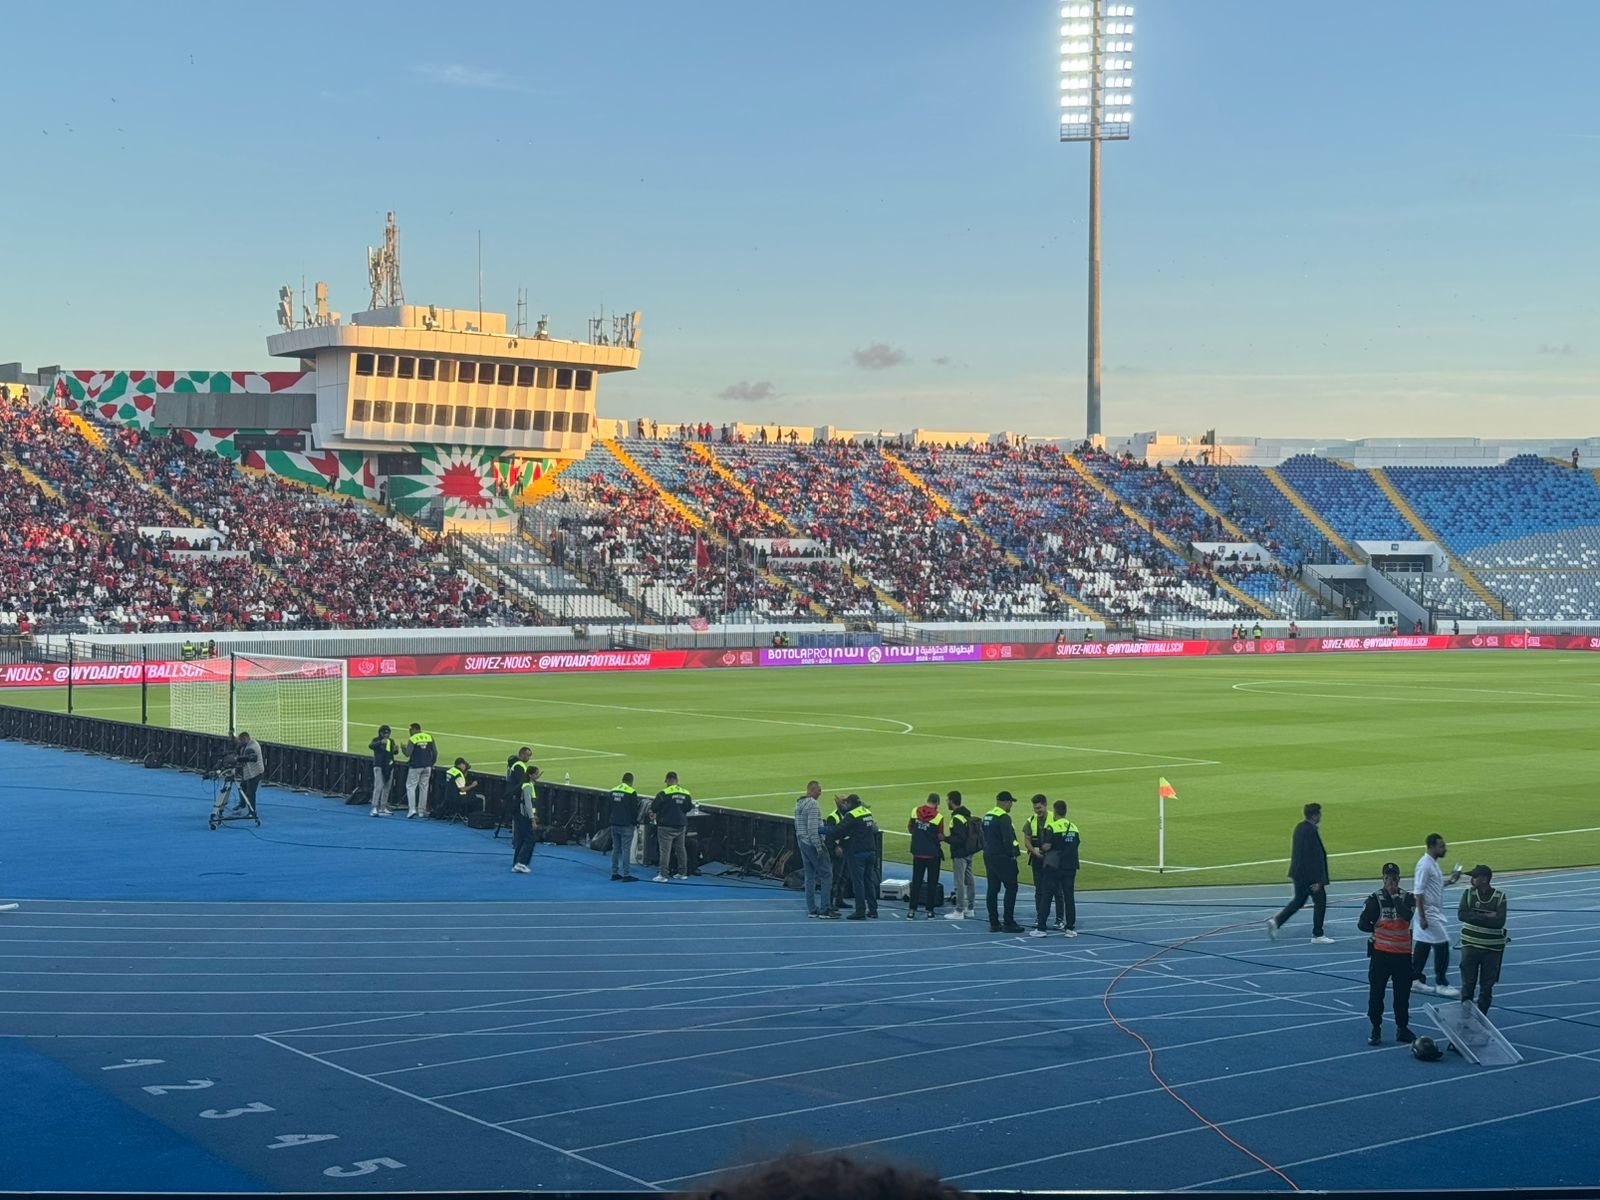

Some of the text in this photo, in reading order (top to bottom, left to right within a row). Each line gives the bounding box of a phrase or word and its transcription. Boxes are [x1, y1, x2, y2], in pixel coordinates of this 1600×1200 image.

[1056, 643, 1102, 656] SUIVEZ-NOUS
[465, 656, 532, 670] SUIVEZ-NOUS
[539, 653, 651, 669] @WYDADFOOTBALLSCH
[0, 667, 44, 682] -NOUS
[101, 1058, 166, 1071] 1
[141, 1079, 216, 1096] 2
[199, 1101, 277, 1119] 3
[266, 1133, 340, 1150] 4
[322, 1157, 407, 1178] 5
